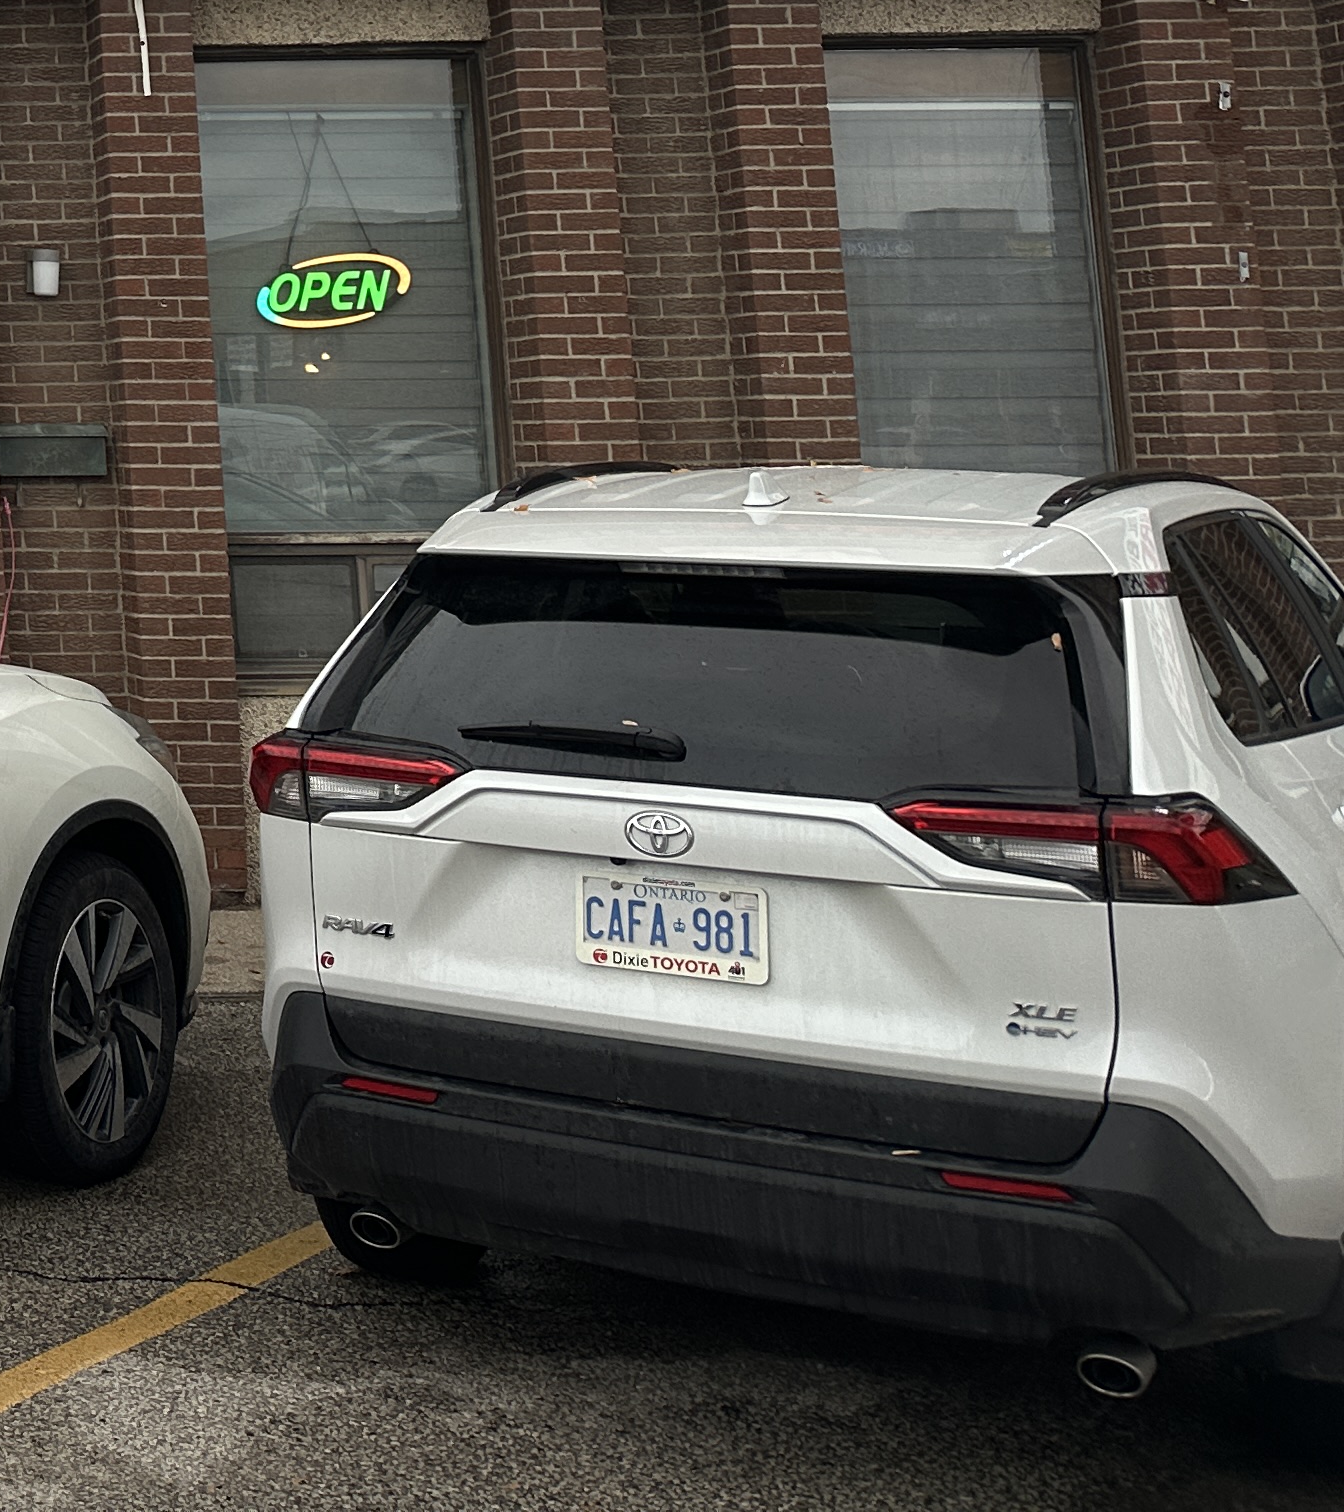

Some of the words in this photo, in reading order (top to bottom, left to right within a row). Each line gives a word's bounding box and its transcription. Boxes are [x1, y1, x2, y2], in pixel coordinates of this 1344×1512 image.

[269, 269, 391, 312] OPEN
[633, 884, 707, 904] ONTARIO
[323, 914, 395, 940] RAV4
[586, 896, 668, 948] CAFA
[692, 907, 754, 957] 981
[612, 950, 649, 968] Dixie
[650, 955, 721, 976] TOYOTA
[1008, 1001, 1078, 1022] XLE
